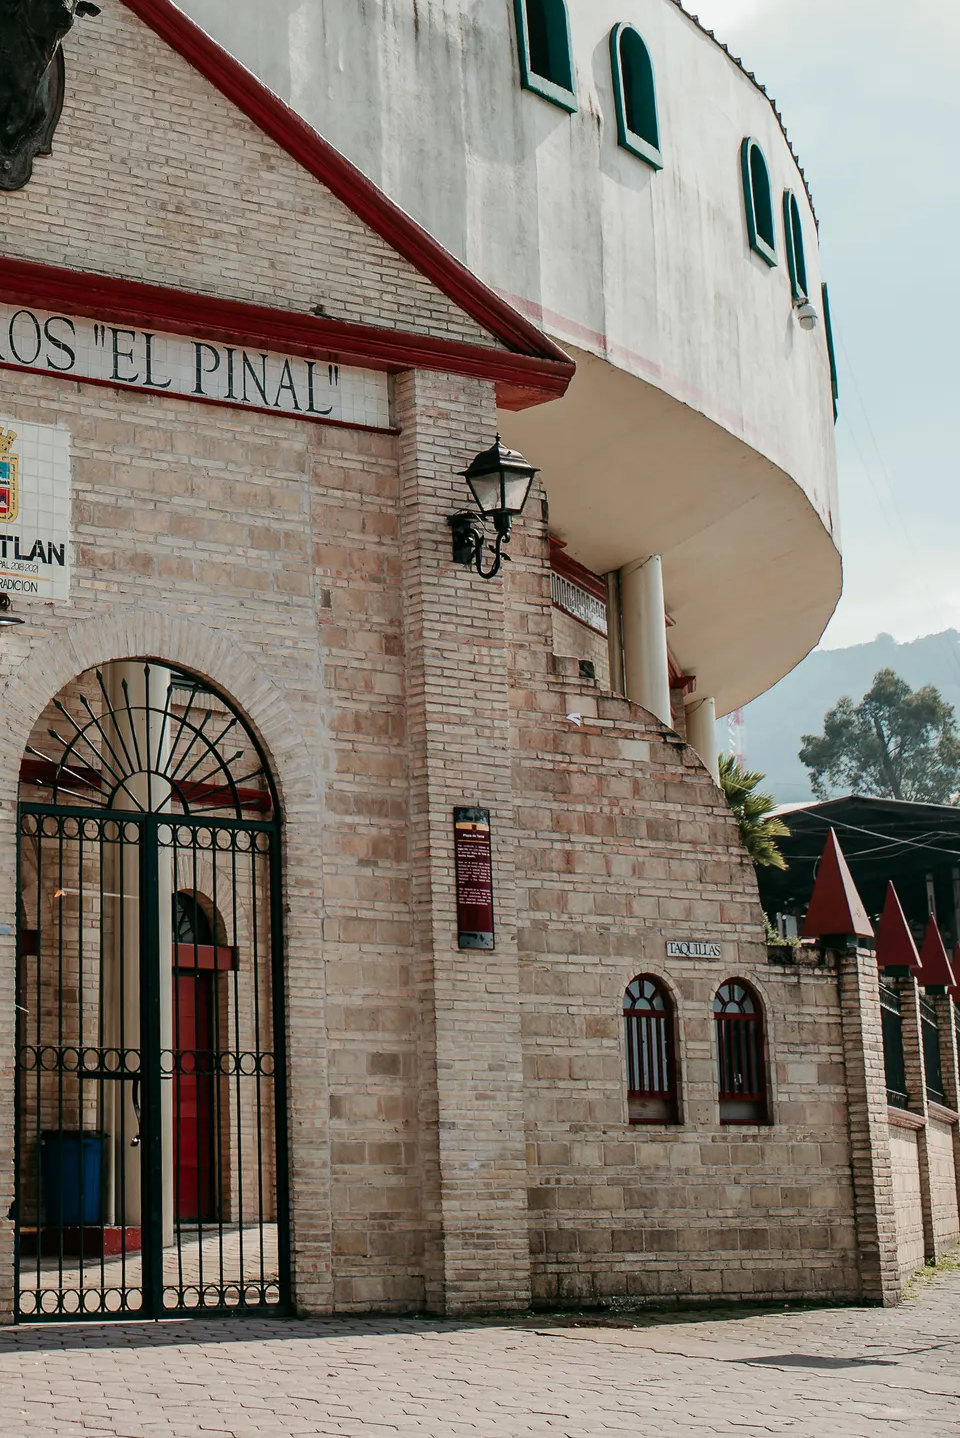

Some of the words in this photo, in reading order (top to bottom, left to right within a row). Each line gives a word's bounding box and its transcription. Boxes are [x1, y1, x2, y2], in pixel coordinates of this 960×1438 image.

[93, 323, 172, 389] "EL
[190, 341, 339, 415] PINAL"
[667, 942, 721, 957] TAQUILLAS
